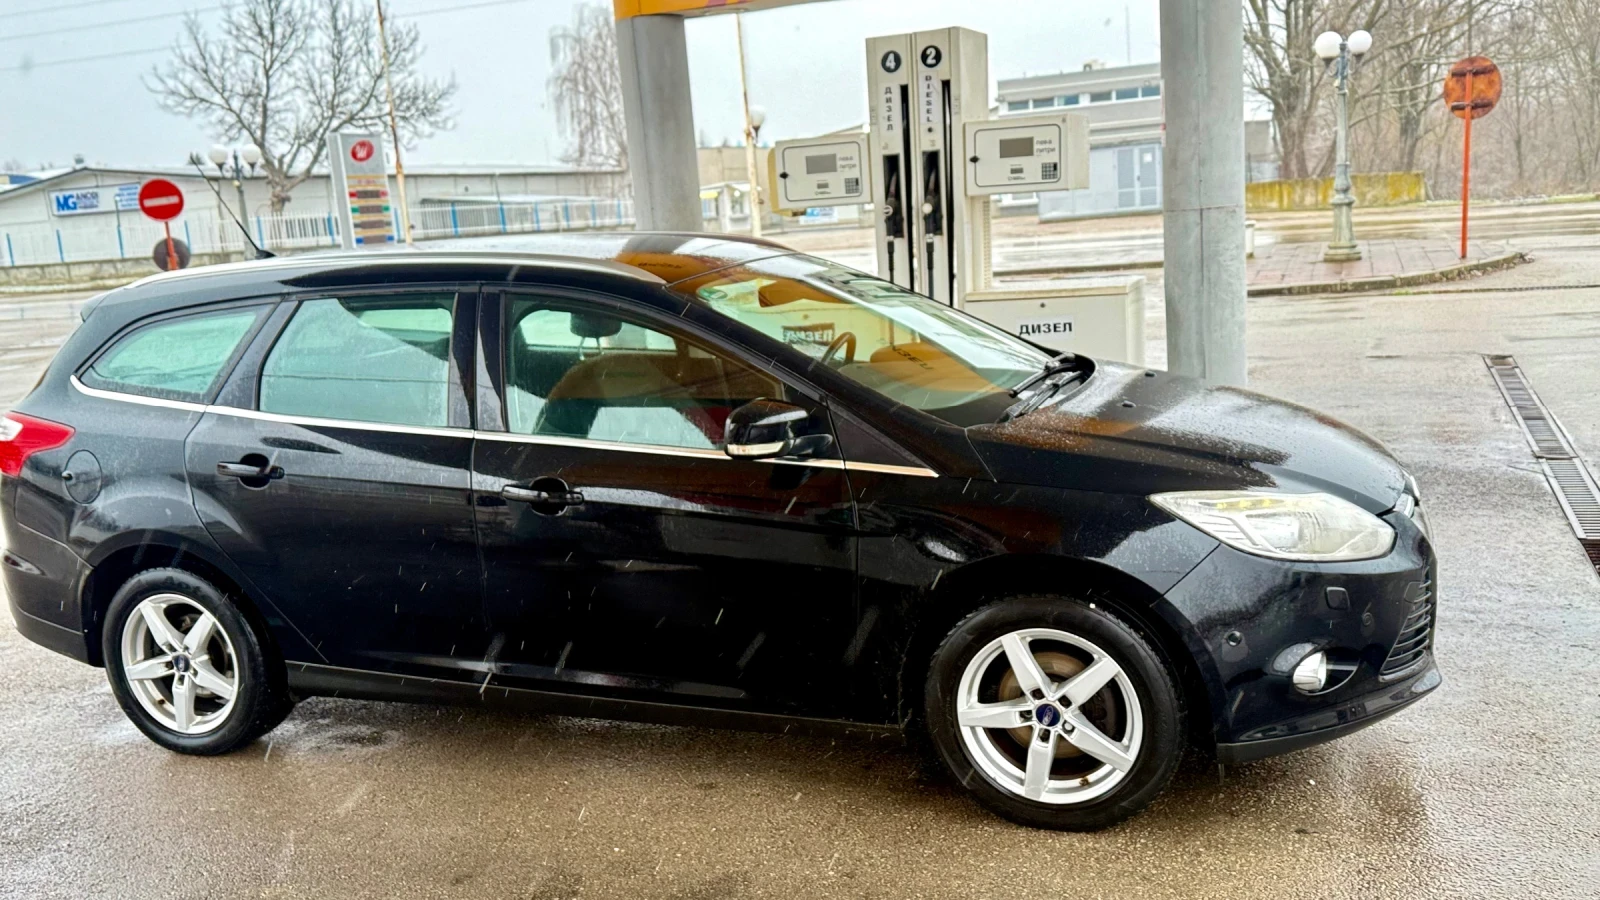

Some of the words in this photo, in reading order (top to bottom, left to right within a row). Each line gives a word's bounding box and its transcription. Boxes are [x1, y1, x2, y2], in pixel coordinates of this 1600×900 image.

[885, 52, 897, 70] 4
[925, 47, 937, 65] 2
[925, 75, 933, 123] DIESEL
[884, 86, 894, 131] ДИЗЕЛ
[55, 194, 78, 212] MG
[1019, 321, 1073, 336] ДИЗЕЛ
